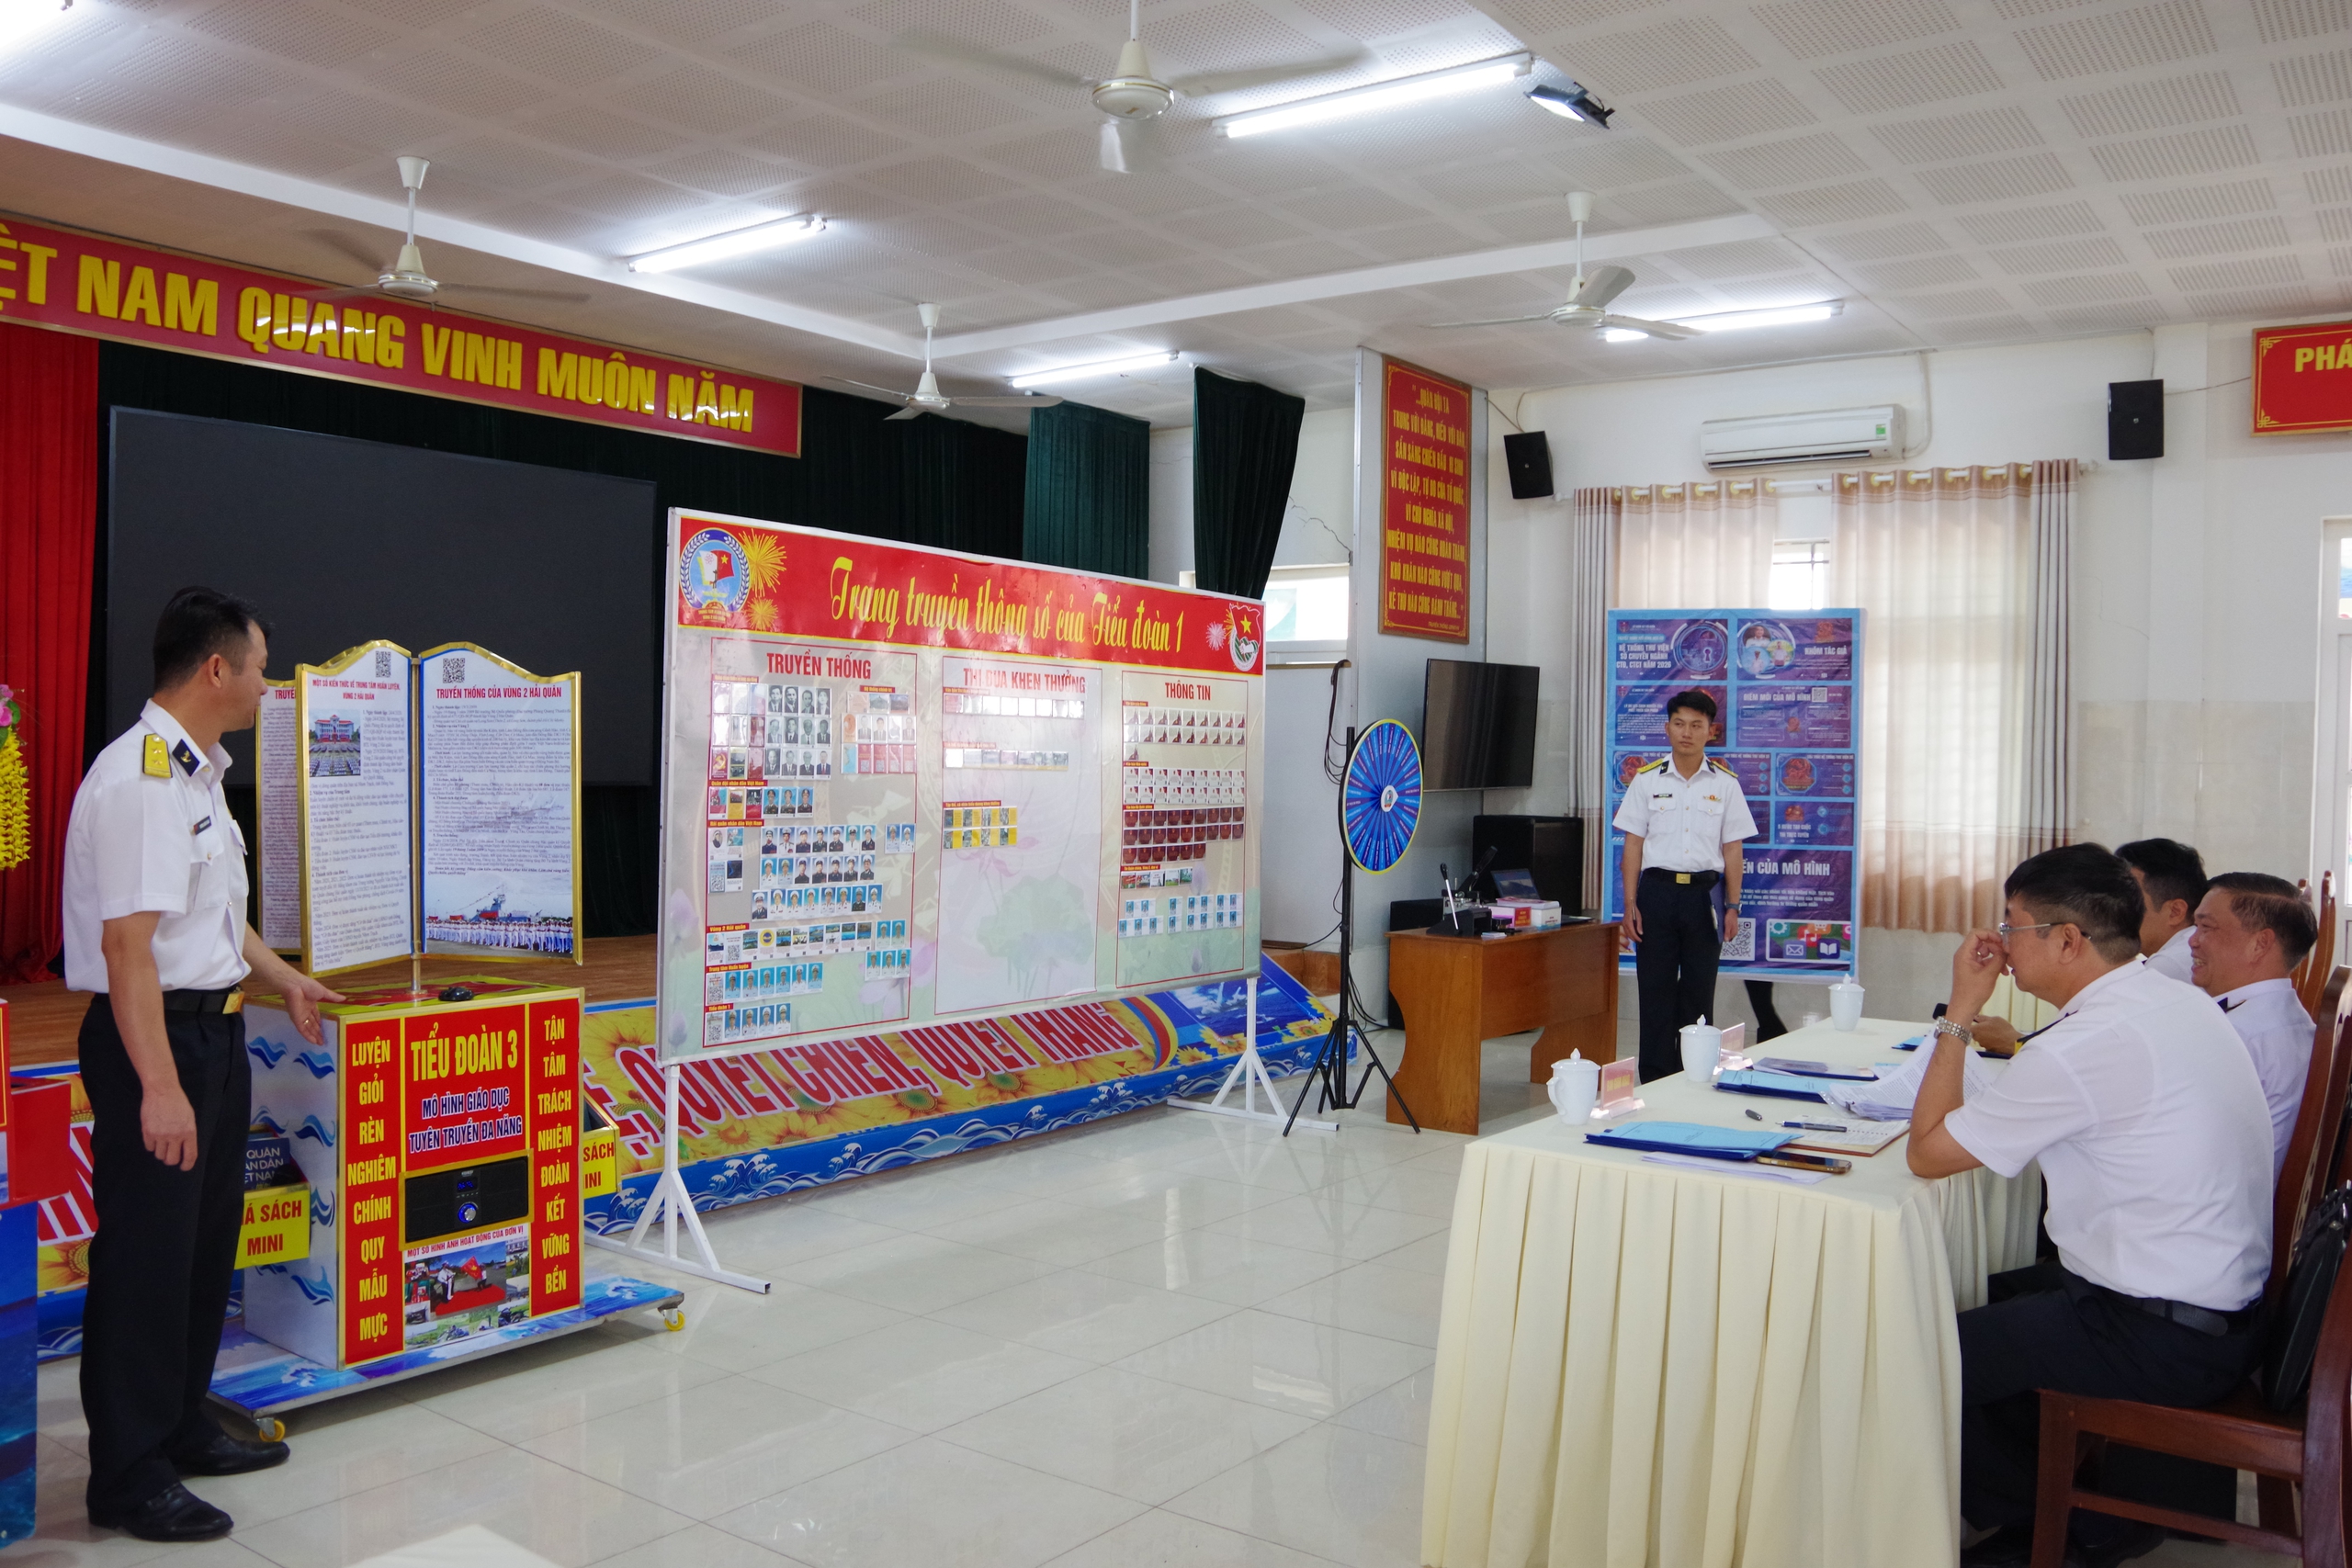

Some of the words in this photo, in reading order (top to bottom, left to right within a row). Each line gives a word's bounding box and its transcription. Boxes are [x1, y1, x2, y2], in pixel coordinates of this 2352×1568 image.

[76, 254, 219, 336] NAM
[237, 287, 405, 368] QUANG
[421, 323, 522, 390] VINH
[537, 347, 656, 415] MUÔN
[666, 370, 753, 433] NĂM
[831, 556, 899, 639] Trang
[905, 573, 969, 642] truyền
[975, 579, 1028, 650] thông
[1033, 590, 1053, 639] số
[1056, 593, 1086, 644] của
[1091, 592, 1128, 648] Tiểu
[1132, 599, 1170, 652] đoàn
[1175, 610, 1184, 653] 1
[766, 649, 822, 676] TRUYỀN
[826, 651, 871, 680] THỐNG
[464, 684, 486, 699] THỐNG
[488, 684, 502, 698] CỦA
[503, 685, 522, 698] VÙNG
[523, 687, 527, 698] 2
[529, 682, 541, 698] HẢI
[542, 684, 562, 698] QUÂN
[963, 668, 982, 686] THI
[1011, 671, 1041, 691] KHEN
[1044, 670, 1086, 694] THƯỞNG
[1164, 680, 1194, 700] THÔNG
[1196, 684, 1211, 701] TIN
[1757, 858, 1779, 874] CỦA
[1781, 859, 1801, 875] MÔ
[1804, 860, 1830, 876] HÌNH
[544, 1013, 565, 1043] TẬN
[352, 1036, 390, 1069] LUYỆN
[411, 1021, 449, 1082] TIỂU
[455, 1030, 503, 1077] ĐOÀN
[507, 1029, 518, 1069] 3
[543, 1051, 566, 1078] TÂM
[358, 1073, 384, 1106] GIỎI
[421, 1092, 439, 1121] MÔ
[440, 1089, 464, 1115] HÌNH
[466, 1086, 490, 1114] GIÁO
[491, 1087, 510, 1113] DỤC
[537, 1087, 571, 1116] TRÁCH
[358, 1117, 385, 1145] RÈN
[408, 1128, 441, 1155] TUYÊN
[442, 1117, 480, 1148] TRUYỀN
[481, 1119, 495, 1143] ĐA
[496, 1114, 523, 1138] NĂNG
[537, 1124, 572, 1155] NHIỆM
[246, 1147, 280, 1159] QUÂN
[259, 1158, 284, 1170] DÂN
[583, 1141, 615, 1162] SÁCH
[347, 1155, 396, 1187] NGHIÊM
[540, 1156, 570, 1187] ĐOÀN
[260, 1200, 302, 1223] SÁCH
[353, 1191, 391, 1225] CHÍNH
[546, 1192, 566, 1223] KẾT
[247, 1234, 283, 1257] MINI
[360, 1236, 386, 1265] QUY
[459, 1235, 475, 1247] HOẠT
[541, 1231, 570, 1259] VỮNG
[358, 1267, 388, 1303] MẪU
[545, 1264, 567, 1295] BỀN
[359, 1313, 388, 1343] MỰC
